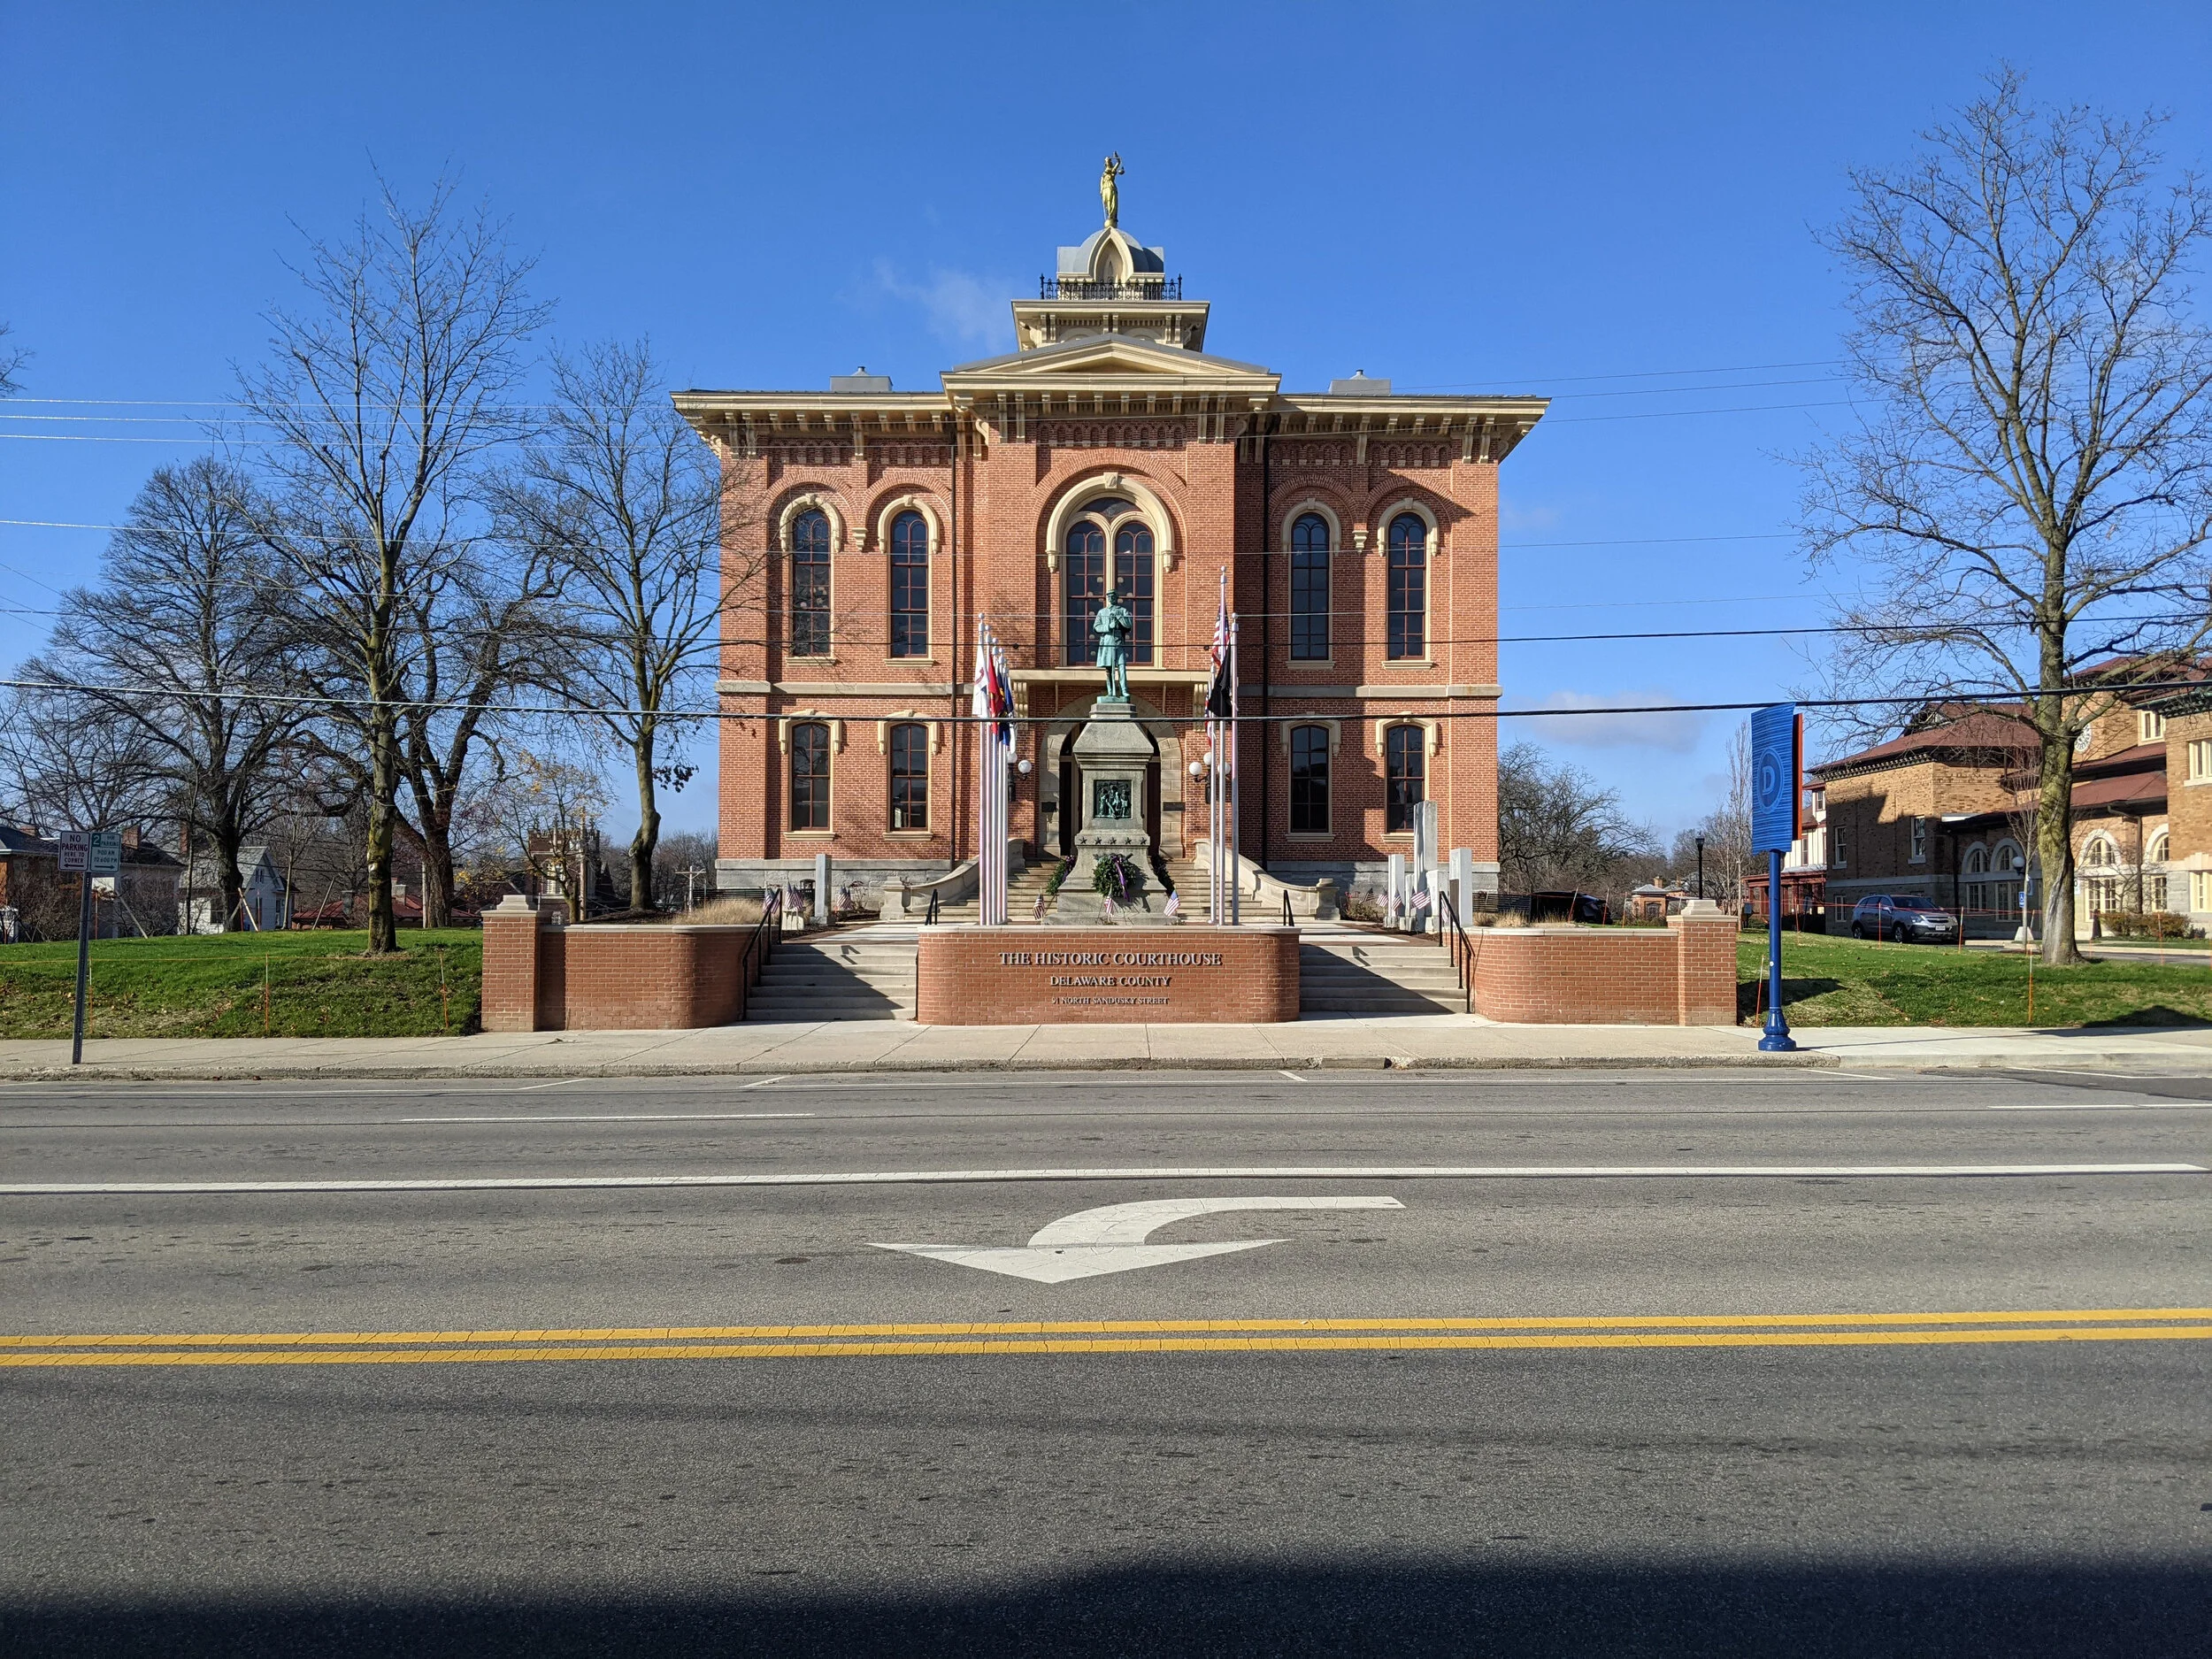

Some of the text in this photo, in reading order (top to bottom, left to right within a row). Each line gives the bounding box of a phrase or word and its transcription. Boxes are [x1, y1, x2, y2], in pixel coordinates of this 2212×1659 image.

[1762, 765, 1776, 795] D
[93, 834, 100, 845] 2
[61, 842, 88, 852] PARKING
[999, 952, 1223, 966] THE HISTORIC COURTHOUSE
[1050, 976, 1171, 987] DELAWARE COUNTY
